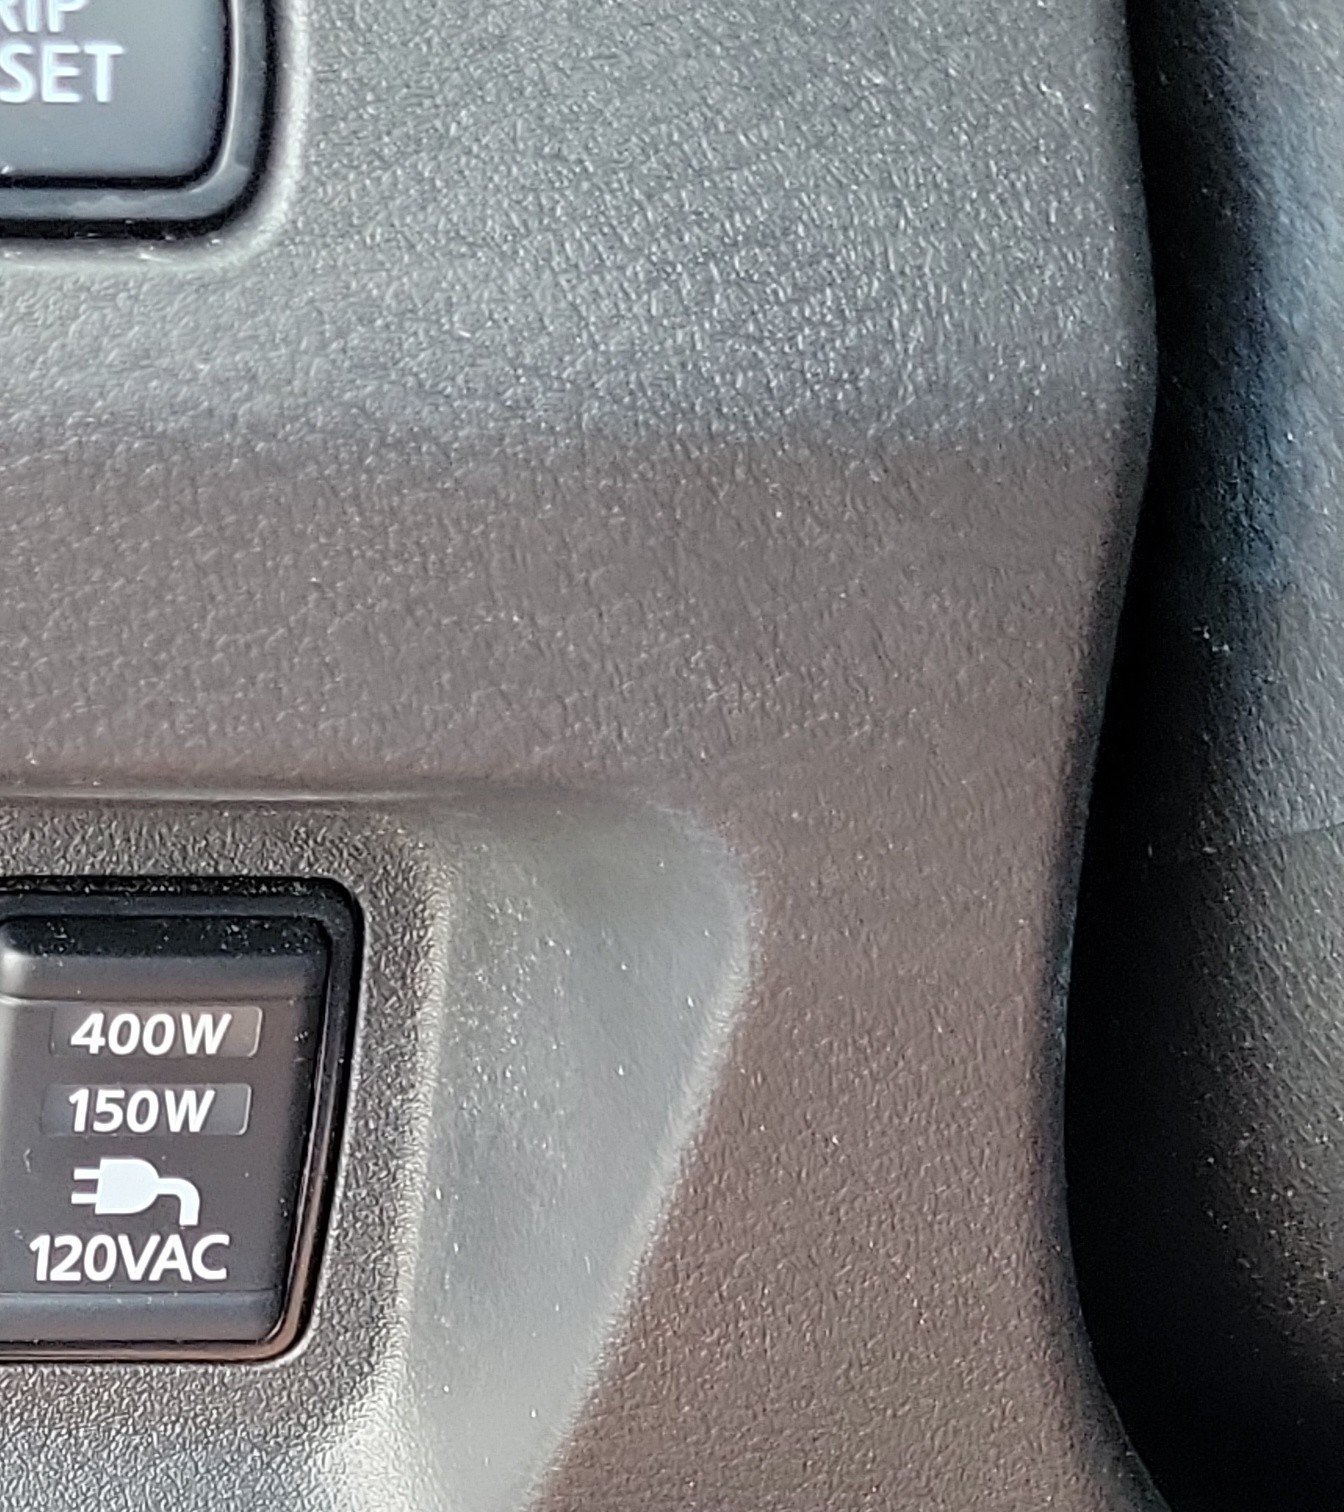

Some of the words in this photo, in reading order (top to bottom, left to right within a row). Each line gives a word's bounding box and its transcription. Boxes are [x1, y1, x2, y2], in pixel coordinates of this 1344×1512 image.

[70, 1012, 233, 1056] 400W
[67, 1088, 216, 1134] 150W
[29, 1233, 230, 1282] 120VAC
